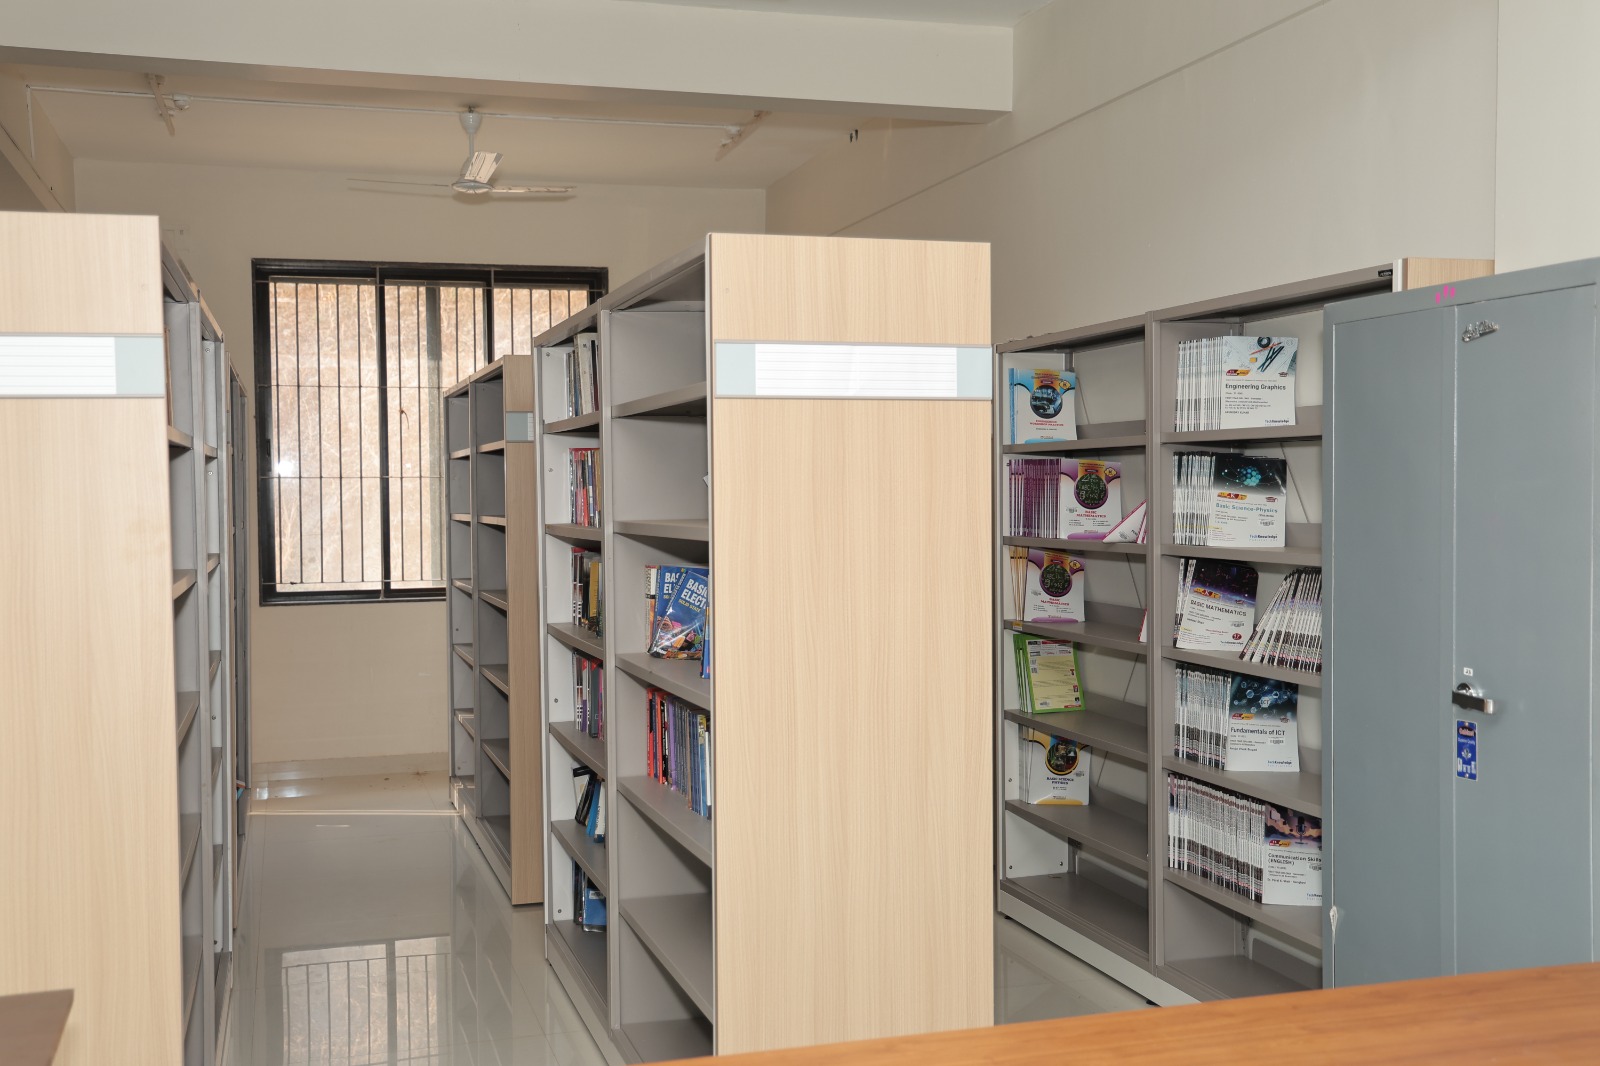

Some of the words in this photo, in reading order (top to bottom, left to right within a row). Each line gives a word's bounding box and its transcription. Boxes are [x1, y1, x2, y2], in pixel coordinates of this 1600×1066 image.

[1260, 383, 1286, 391] Graphics
[1216, 502, 1231, 510] Basic
[1190, 599, 1205, 608] BASIC
[1205, 603, 1247, 617] MATHEMATICS
[1230, 727, 1268, 735] Fundamentals
[1268, 852, 1307, 861] Communication
